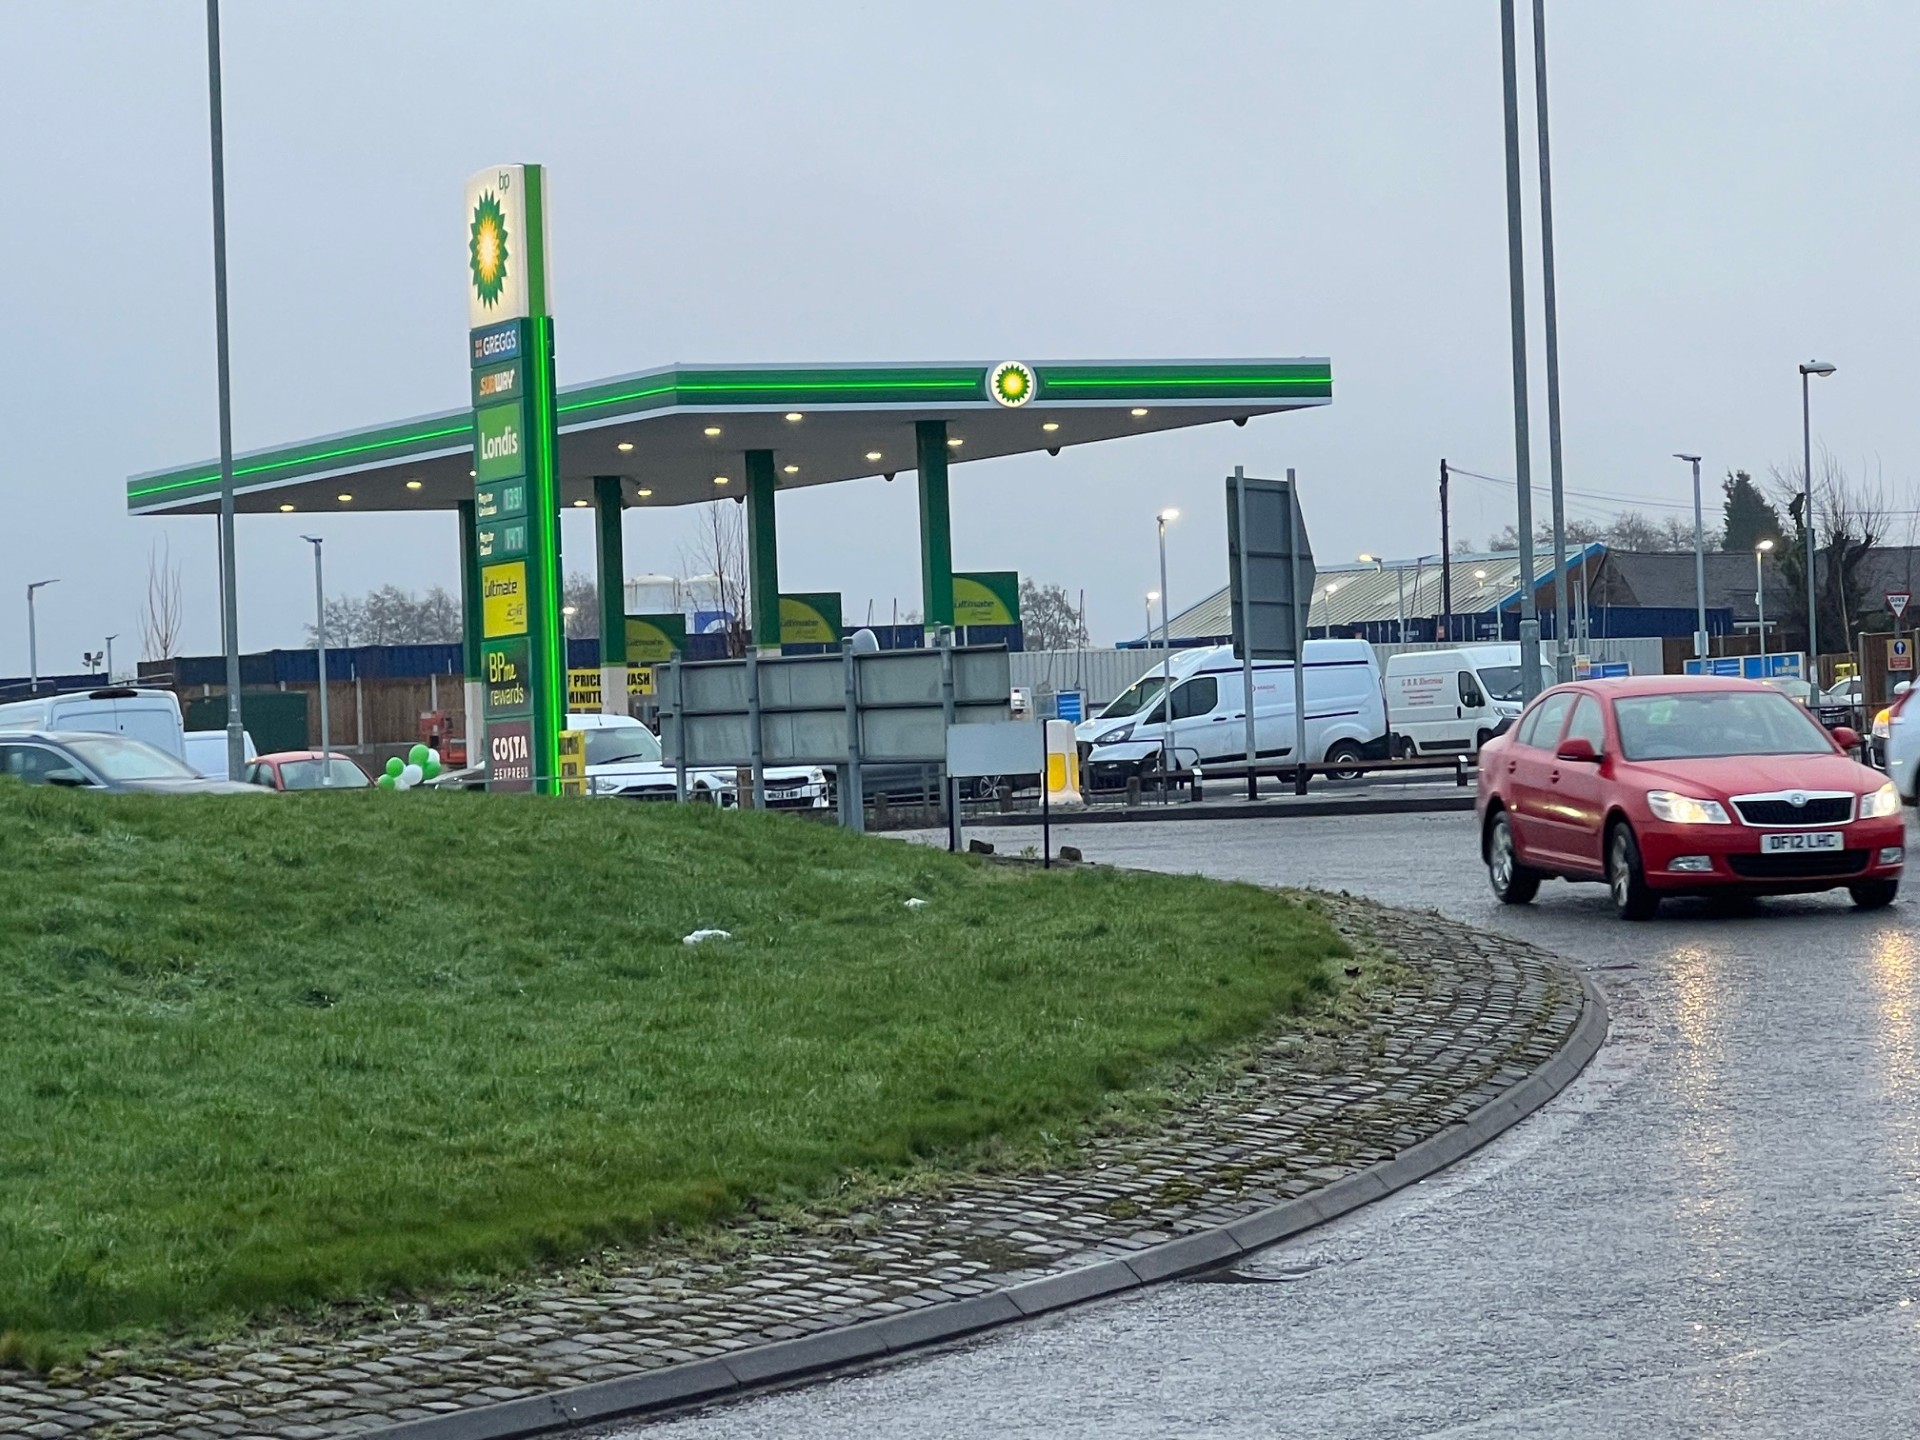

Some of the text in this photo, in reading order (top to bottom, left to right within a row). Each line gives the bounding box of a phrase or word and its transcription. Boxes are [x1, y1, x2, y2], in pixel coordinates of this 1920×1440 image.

[499, 170, 510, 194] bp
[483, 330, 517, 356] GREGGS
[481, 425, 518, 460] Londis
[490, 683, 524, 706] rewards
[493, 736, 528, 763] COSTA
[499, 766, 528, 780] EXPRESS
[1807, 834, 1836, 848] LHC
